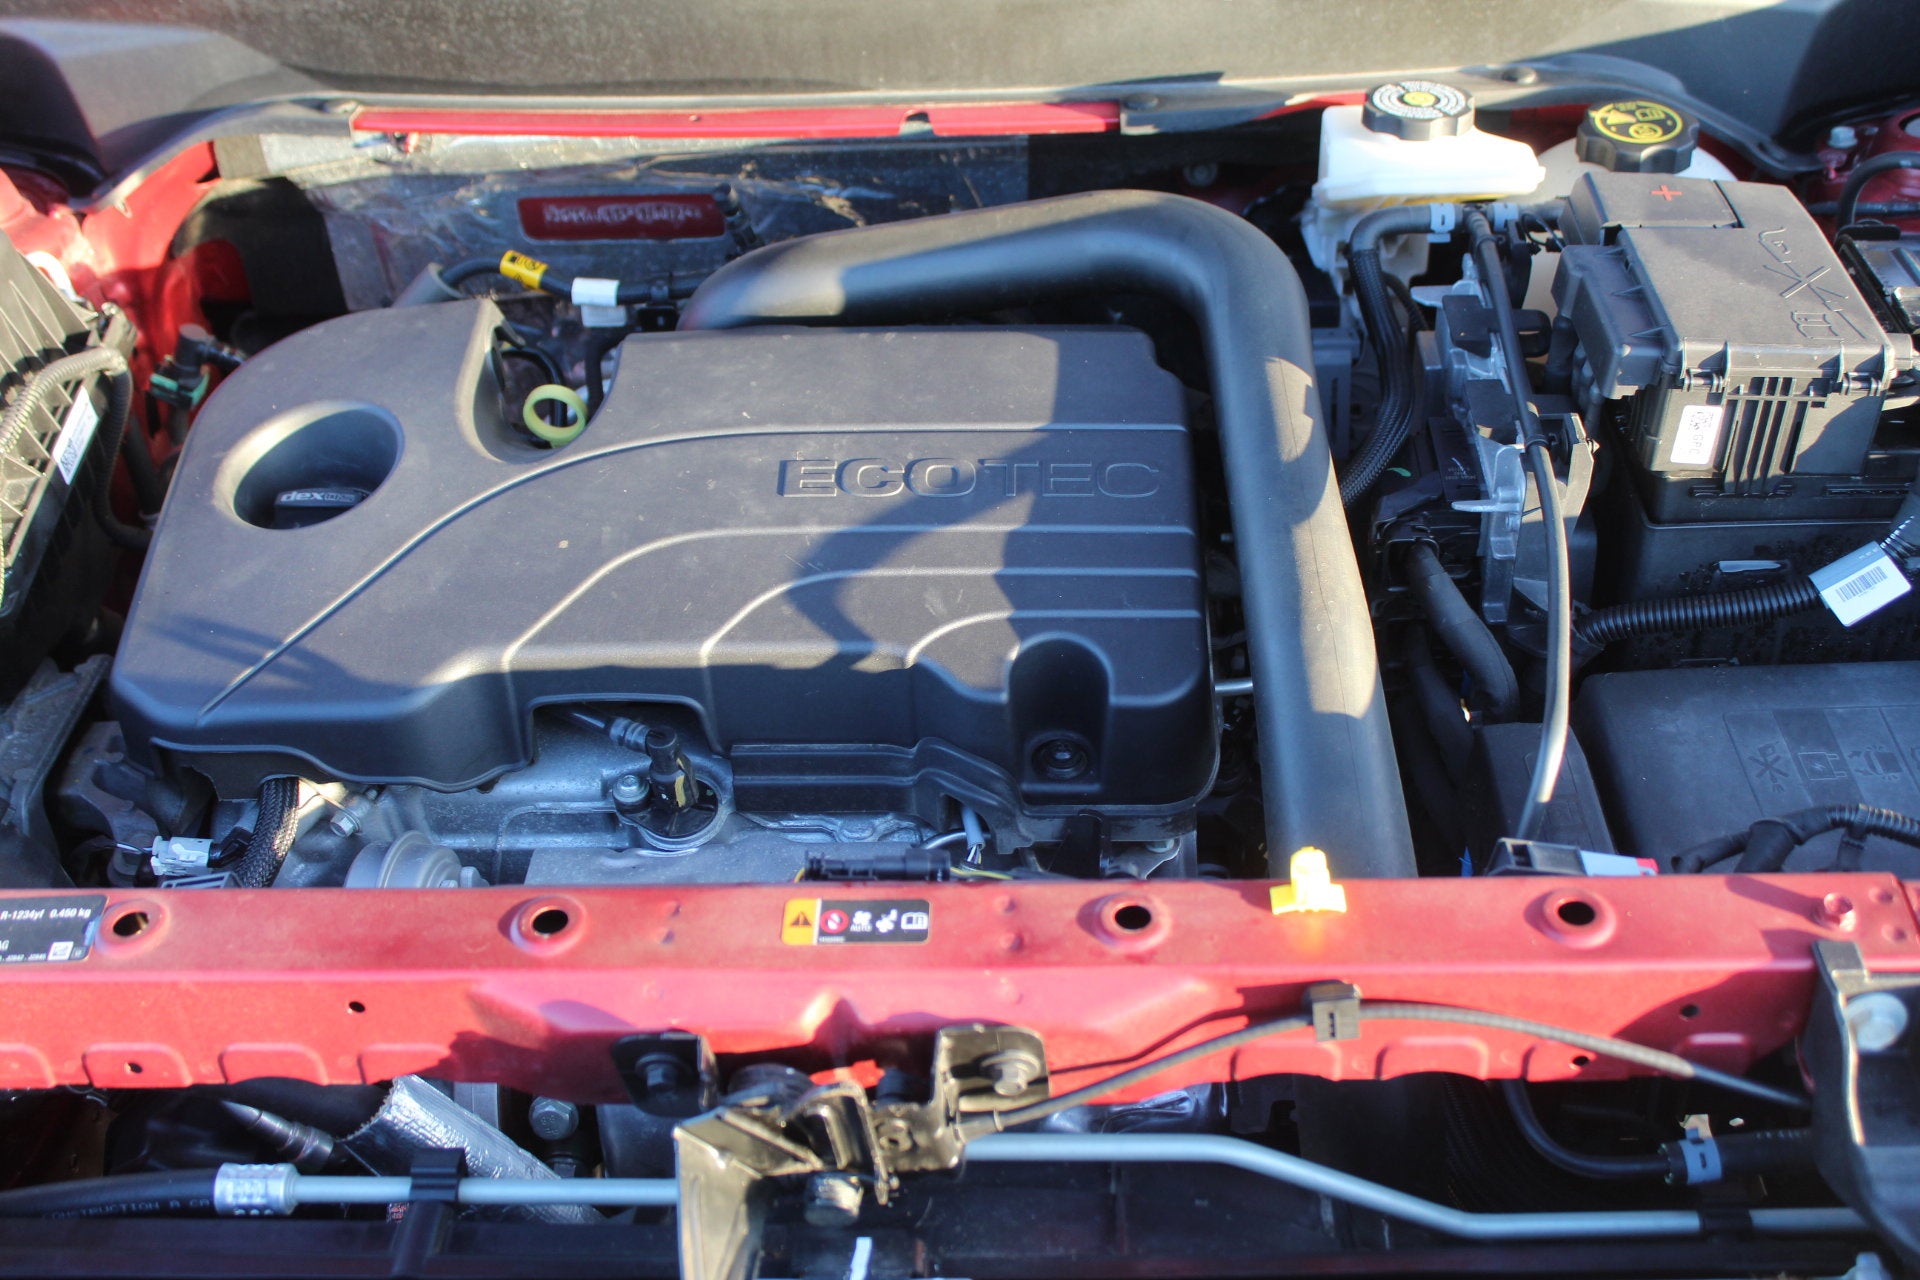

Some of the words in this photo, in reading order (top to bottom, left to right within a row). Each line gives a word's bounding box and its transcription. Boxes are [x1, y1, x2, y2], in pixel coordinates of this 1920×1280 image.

[777, 457, 1160, 498] ECOTEC
[0, 909, 45, 921] R-1234yf
[49, 908, 77, 919] 0.450
[78, 907, 92, 919] kg
